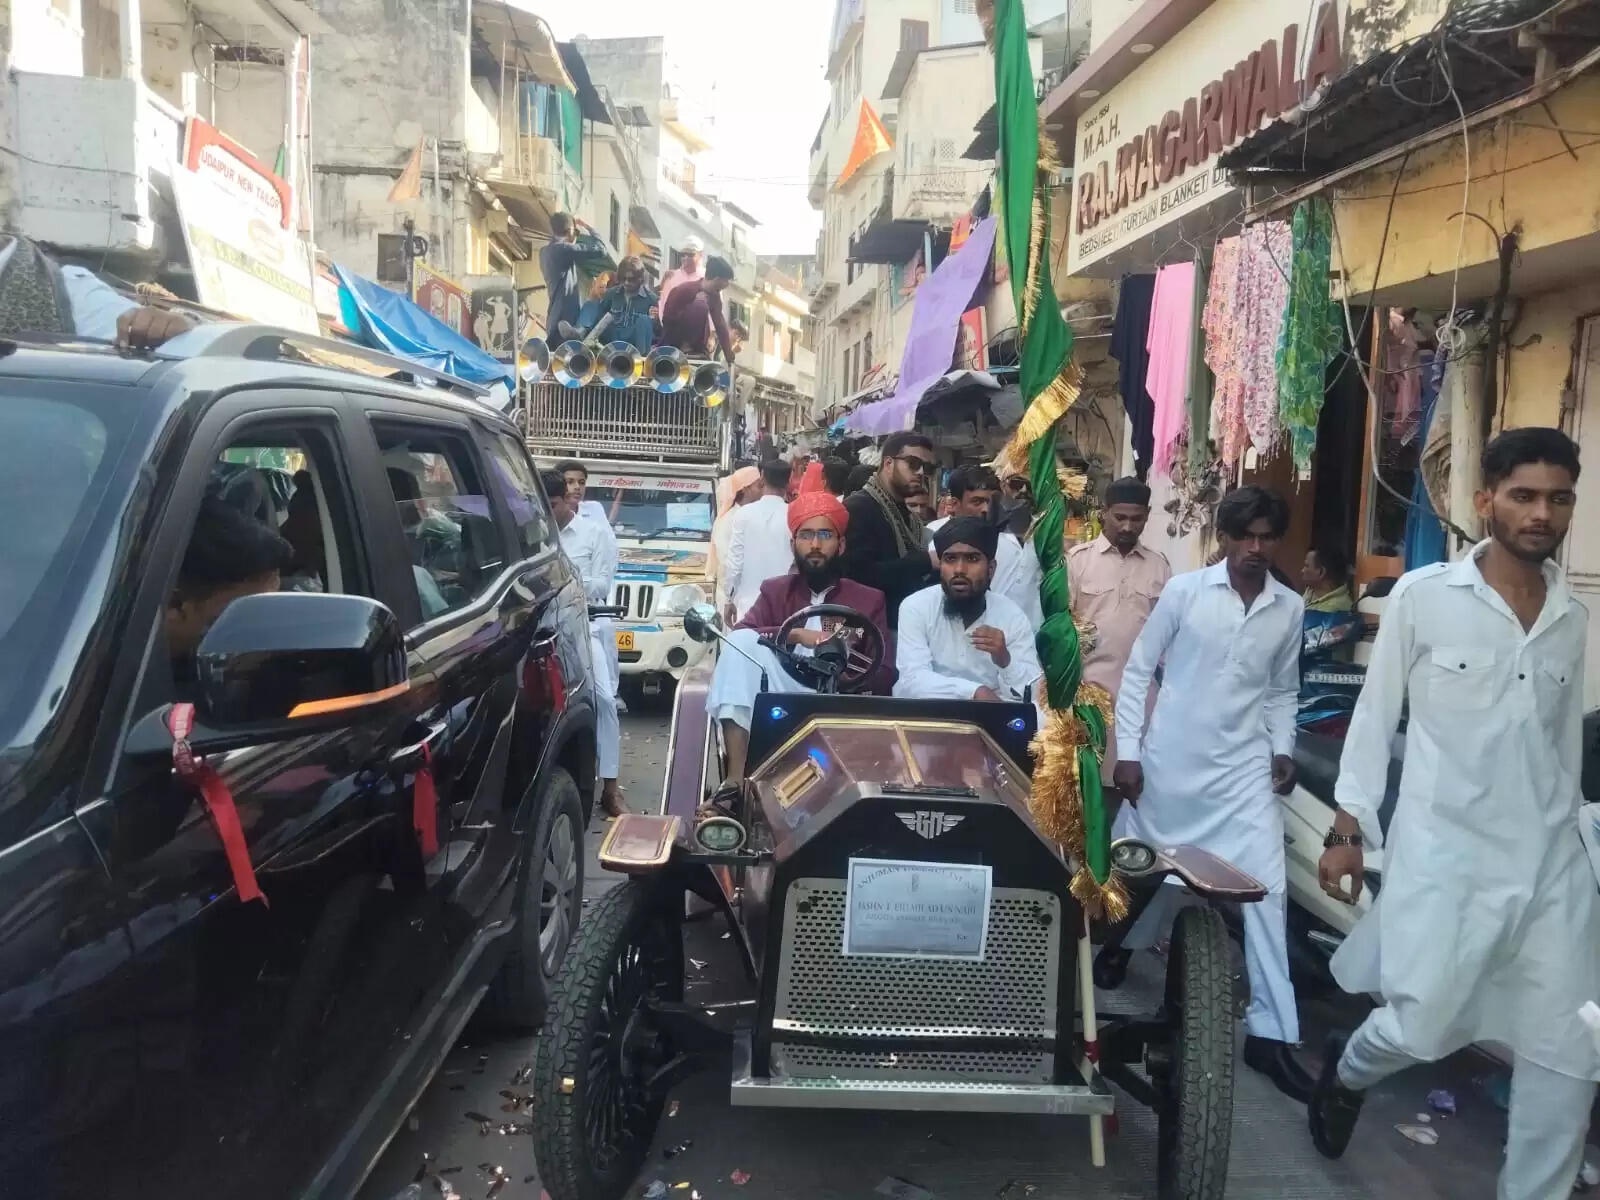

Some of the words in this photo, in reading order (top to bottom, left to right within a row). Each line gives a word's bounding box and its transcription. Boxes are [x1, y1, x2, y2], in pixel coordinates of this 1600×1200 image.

[1076, 0, 1341, 235] RAJNAGARWALA
[1083, 114, 1121, 160] M.A.H.
[201, 151, 235, 181] UDAIPUR
[237, 175, 254, 193] NEW
[256, 186, 280, 209] TAILOR
[1080, 228, 1118, 257] BEDSHEET
[1122, 202, 1157, 231] CURTAIN
[1160, 173, 1208, 212] BLANKET
[618, 634, 632, 646] 46
